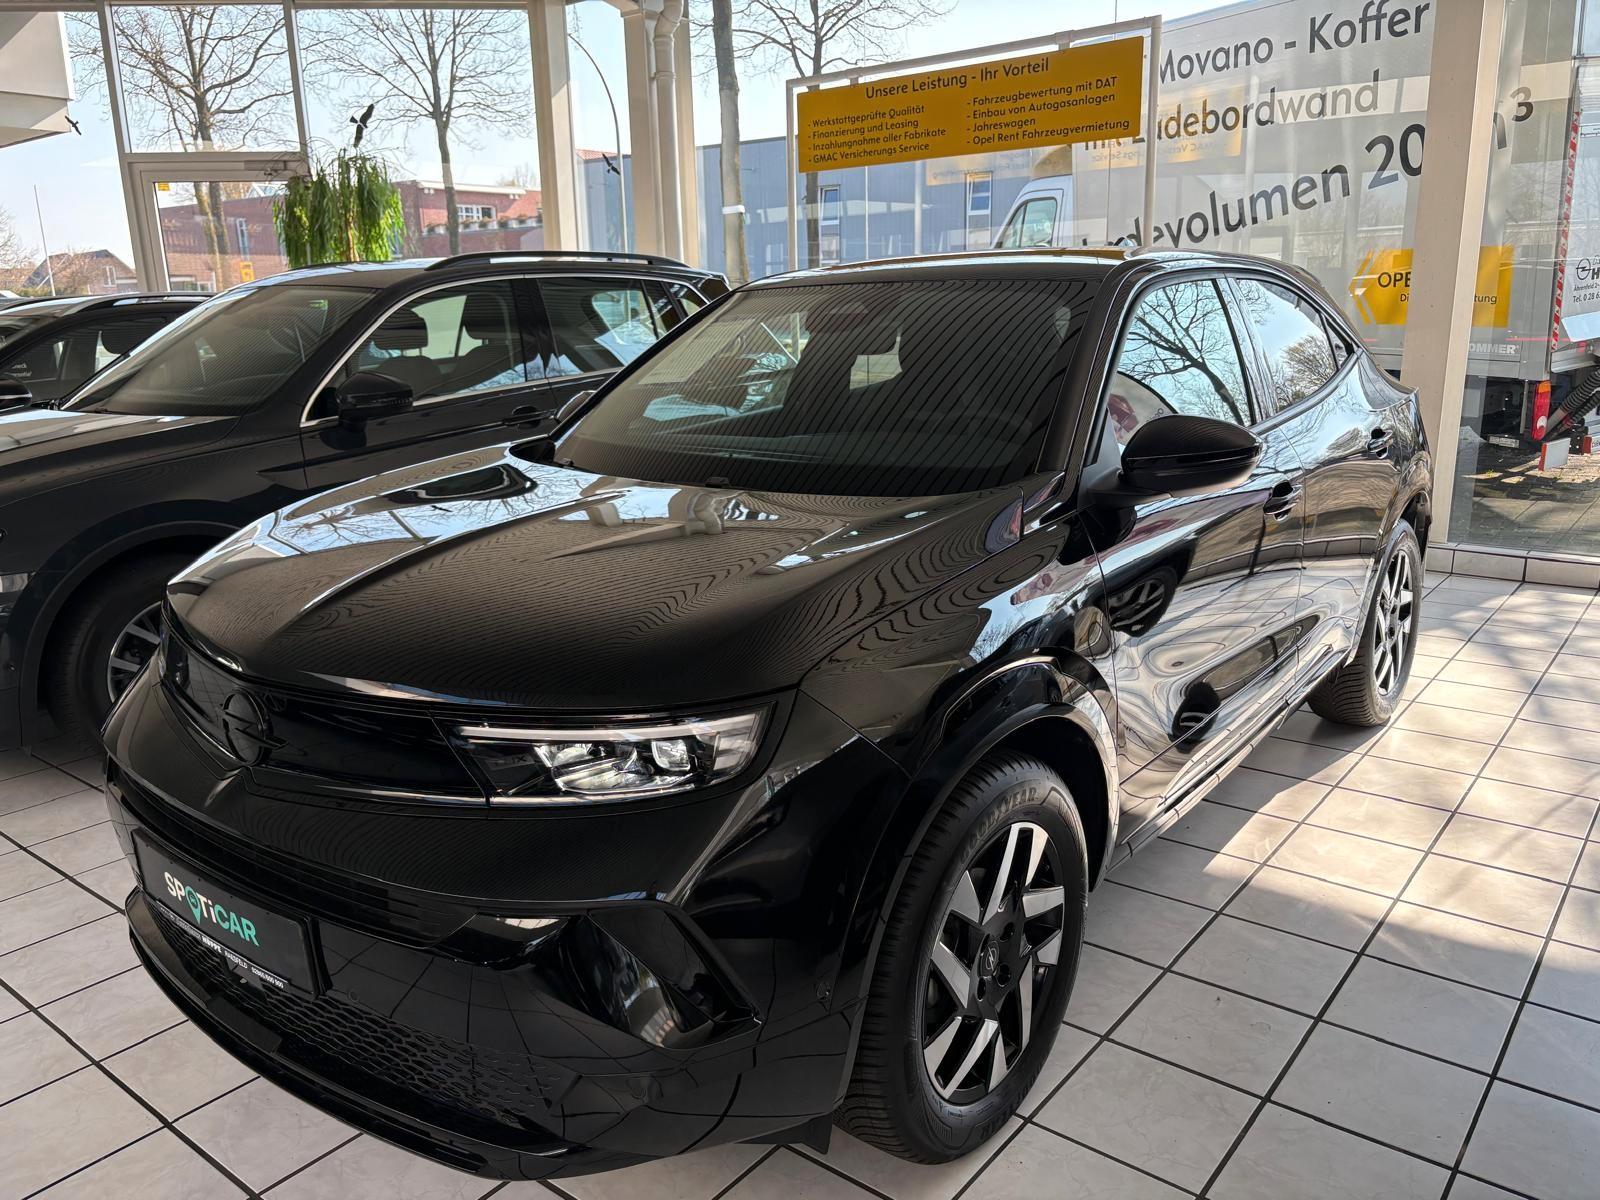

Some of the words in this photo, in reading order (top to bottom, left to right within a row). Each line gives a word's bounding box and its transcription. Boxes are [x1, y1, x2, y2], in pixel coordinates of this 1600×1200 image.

[1309, 0, 1431, 54] Koffer
[866, 83, 908, 99] Unsere
[912, 73, 967, 92] Leistung
[980, 68, 999, 82] Ihr
[1003, 58, 1049, 77] Vorteil
[973, 85, 1073, 107] Fahrzeugbewertung
[1075, 80, 1092, 92] mit
[1095, 76, 1117, 88] DAT
[812, 111, 886, 127] Werkstattgeprüfte
[888, 105, 925, 119] Qualität
[973, 107, 1006, 119] Einbau
[1008, 105, 1026, 115] von
[1028, 93, 1115, 112] Autogasanlagen
[812, 127, 865, 140] Finanzierung
[867, 124, 883, 133] und
[885, 119, 919, 130] Leasing
[973, 118, 1036, 133] Jahreswagen
[973, 134, 995, 146] Opel
[997, 130, 1019, 141] Rent
[1022, 119, 1130, 139] Fahrzeugvermietung
[813, 136, 881, 151] Inzahlungnahme
[883, 133, 902, 143] aller
[904, 128, 947, 140] Fabrikate
[813, 152, 838, 164] GMAC
[839, 146, 897, 159] Versicherungs
[899, 142, 930, 153] Service
[1470, 342, 1517, 355] OMMER
